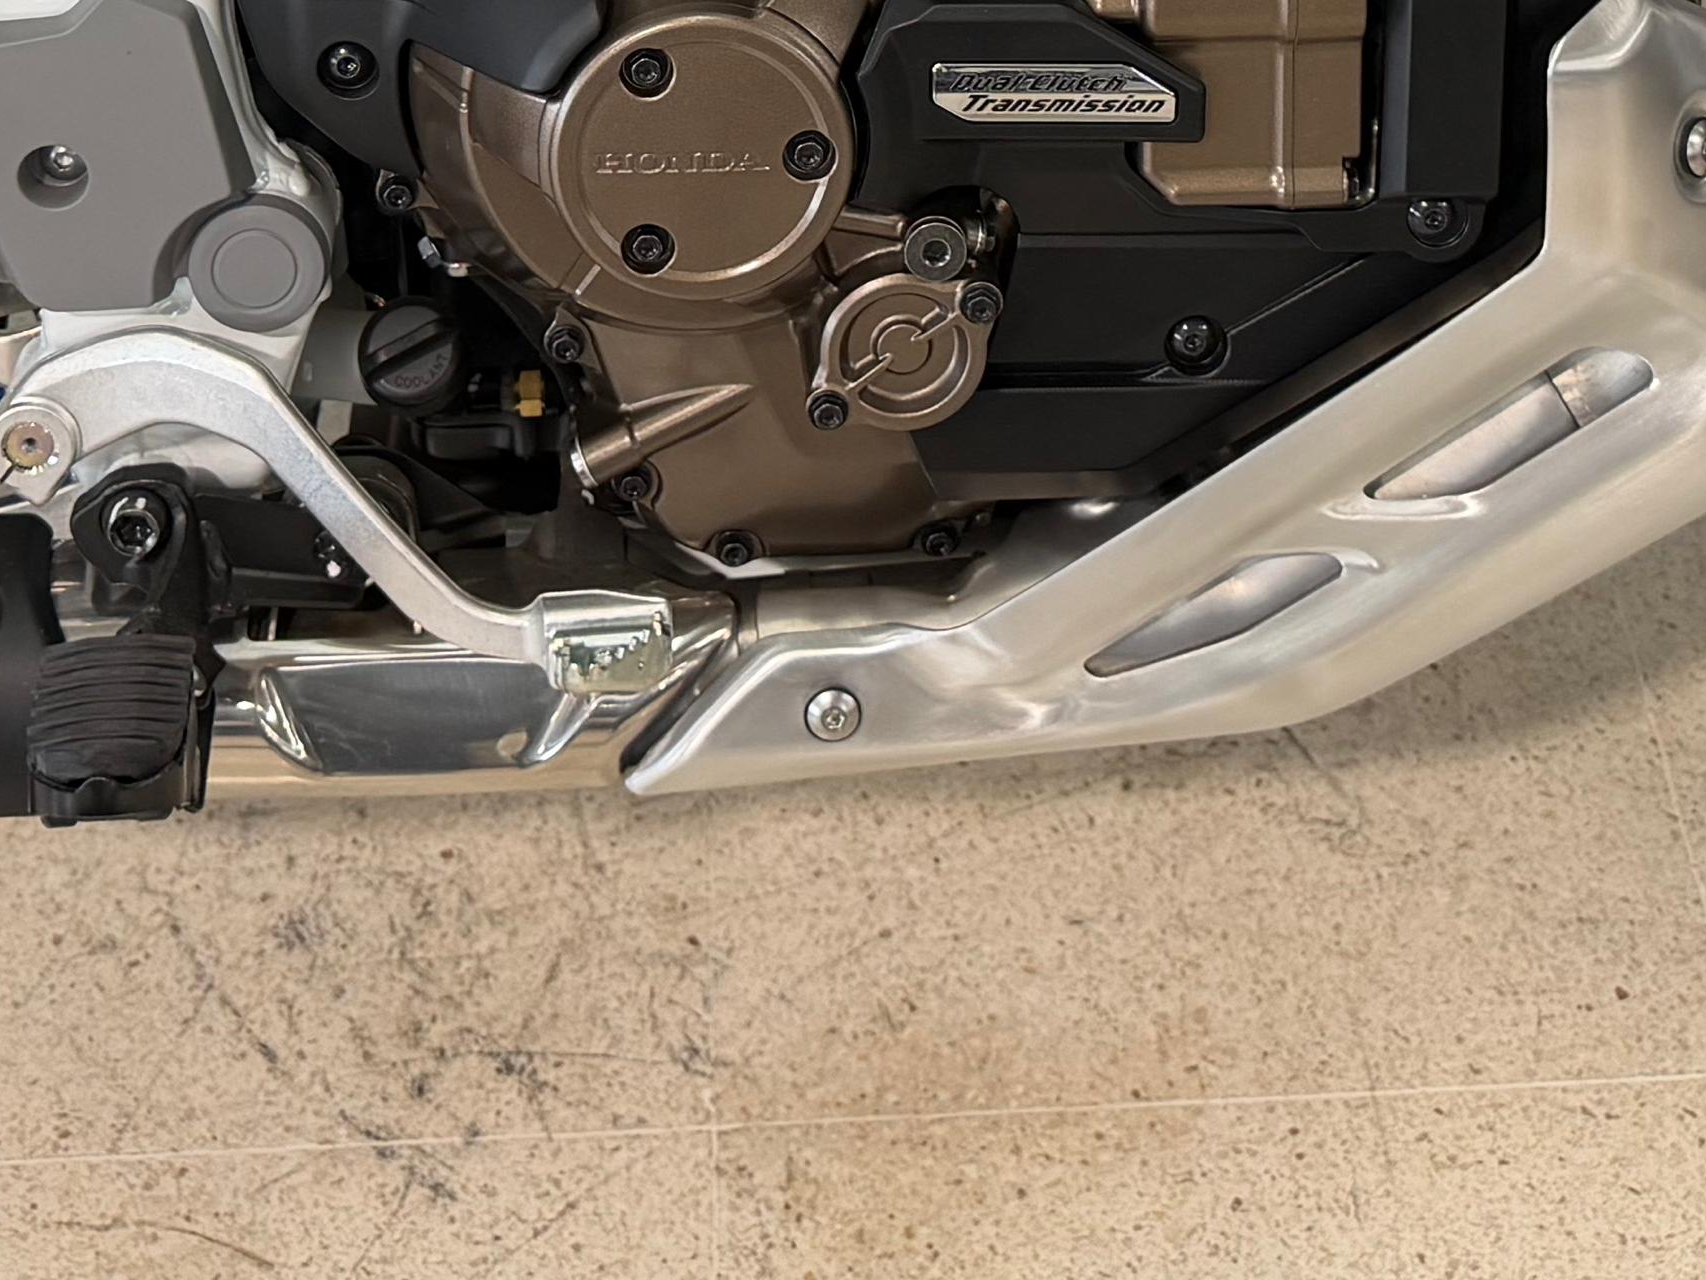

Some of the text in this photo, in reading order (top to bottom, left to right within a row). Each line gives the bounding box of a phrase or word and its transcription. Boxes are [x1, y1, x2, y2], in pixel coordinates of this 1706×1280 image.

[961, 94, 1166, 114] Transmission
[592, 151, 771, 175] HONDA
[393, 352, 449, 389] COOLANT
